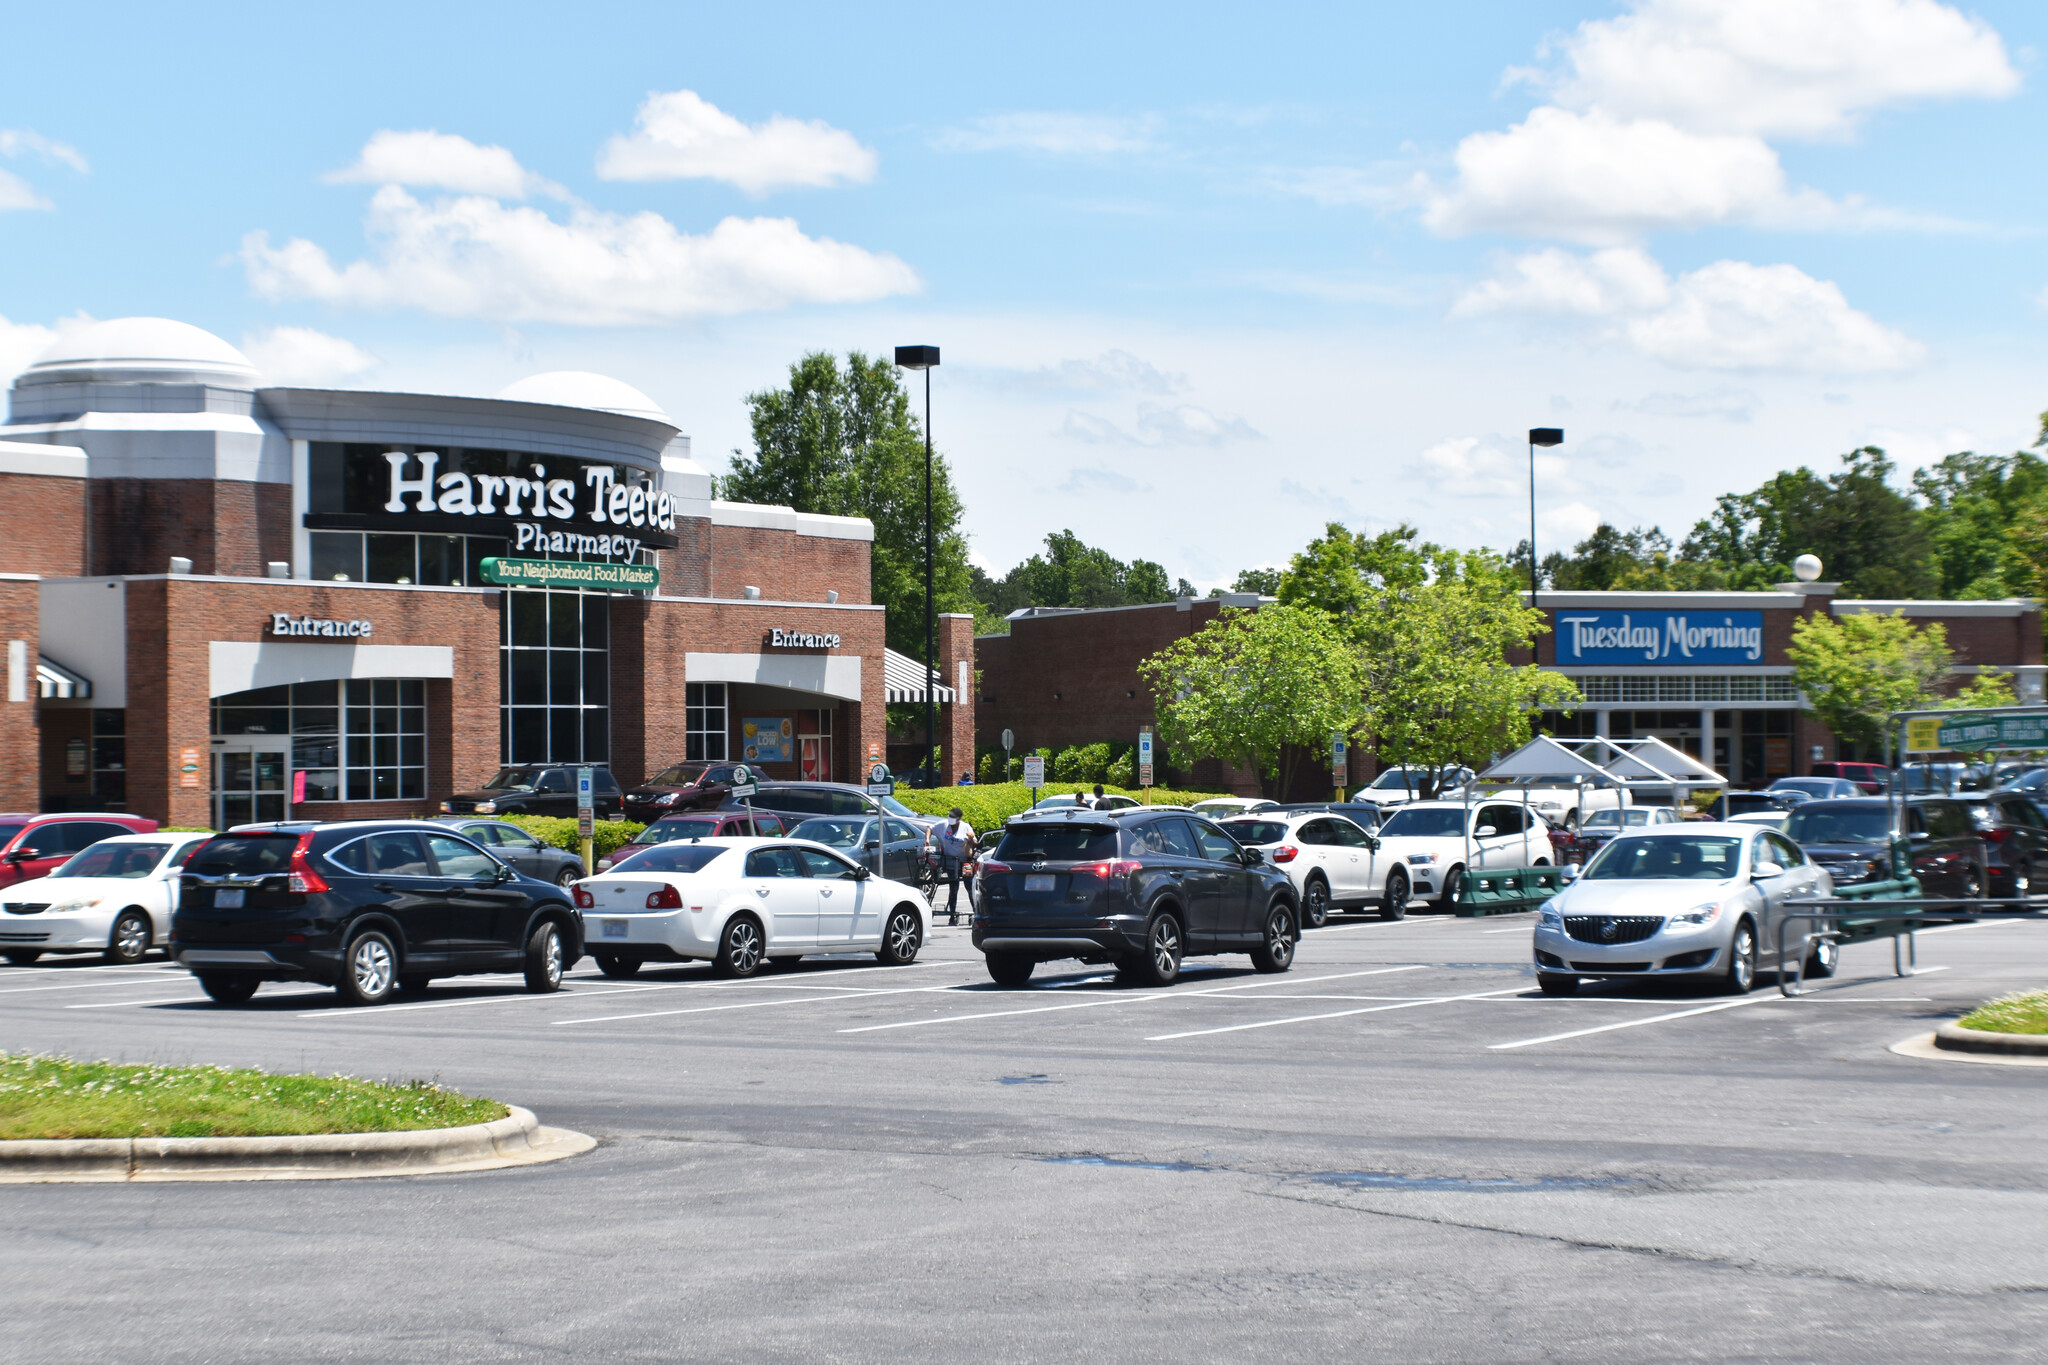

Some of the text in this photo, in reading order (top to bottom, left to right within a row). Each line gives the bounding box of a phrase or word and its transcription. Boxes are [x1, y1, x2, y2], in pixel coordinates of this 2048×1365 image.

[381, 451, 679, 531] Harris Teeter
[513, 522, 641, 565] Pharmacy
[497, 560, 654, 583] Your Neighborhood Food Market
[271, 612, 373, 637] Entrance
[1560, 614, 1761, 660] Tuesday Morning
[769, 628, 841, 648] Entrance
[1941, 728, 1963, 744] FUEL
[1963, 723, 1998, 740] POINTS
